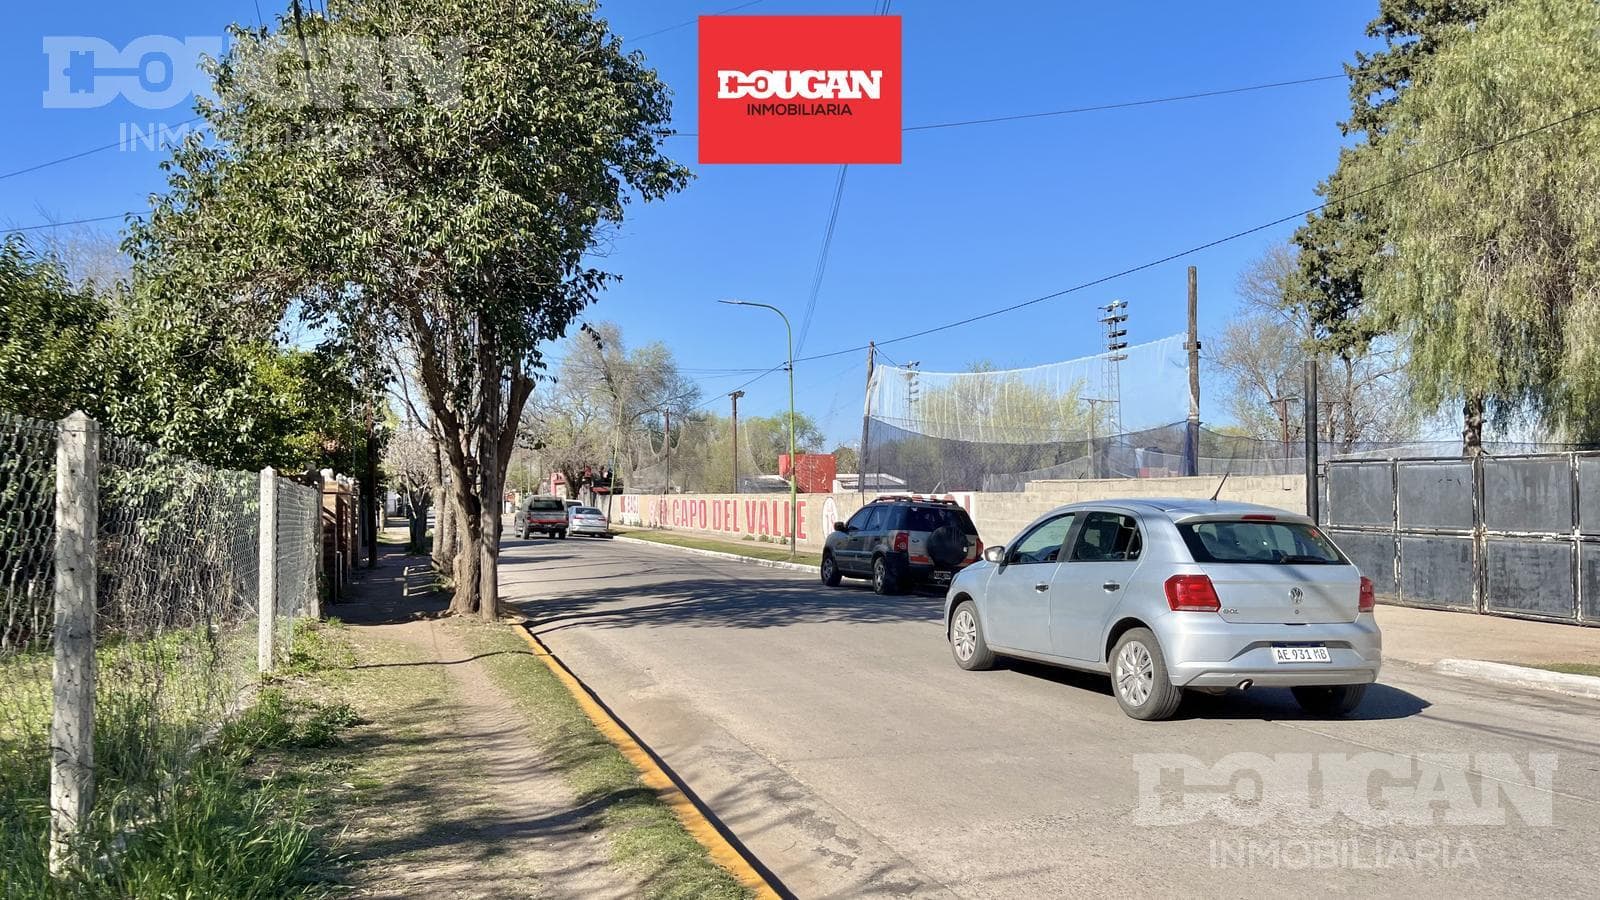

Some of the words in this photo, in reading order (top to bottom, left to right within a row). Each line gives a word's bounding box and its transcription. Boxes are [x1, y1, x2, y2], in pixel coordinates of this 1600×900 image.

[673, 499, 706, 529] CAPO
[712, 500, 740, 532] DEL
[745, 500, 806, 539] VALLE
[1277, 649, 1291, 660] AE
[1292, 649, 1312, 660] 931
[1314, 649, 1327, 660] MB
